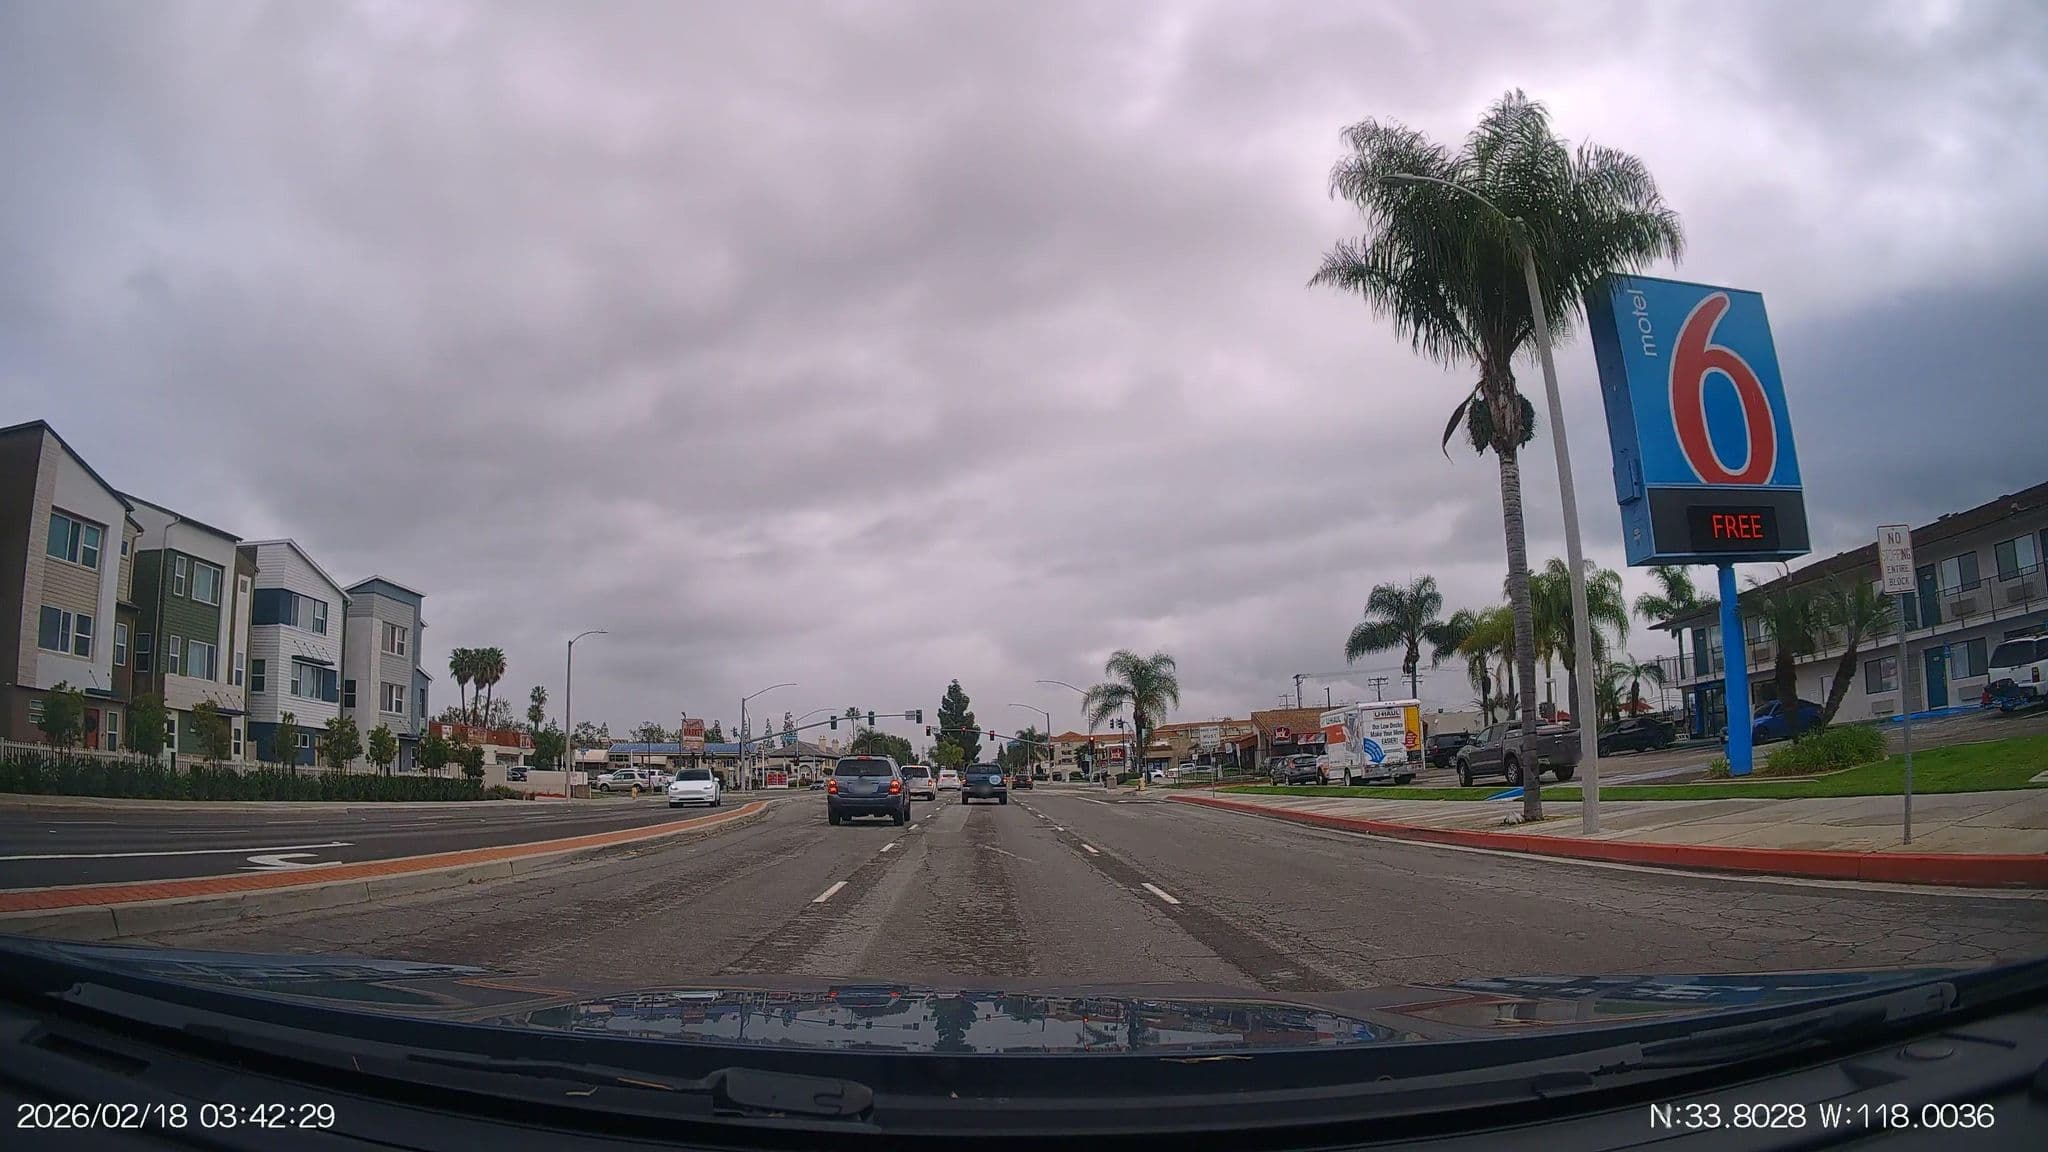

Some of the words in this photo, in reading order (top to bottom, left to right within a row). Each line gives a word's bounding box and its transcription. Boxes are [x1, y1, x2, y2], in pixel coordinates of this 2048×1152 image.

[1627, 289, 1658, 358] motel
[1668, 291, 1778, 486] 6
[1711, 514, 1765, 540] FREE
[1887, 532, 1901, 544] NO
[1887, 564, 1911, 574] ENTIRE
[1888, 576, 1910, 587] BLOCK
